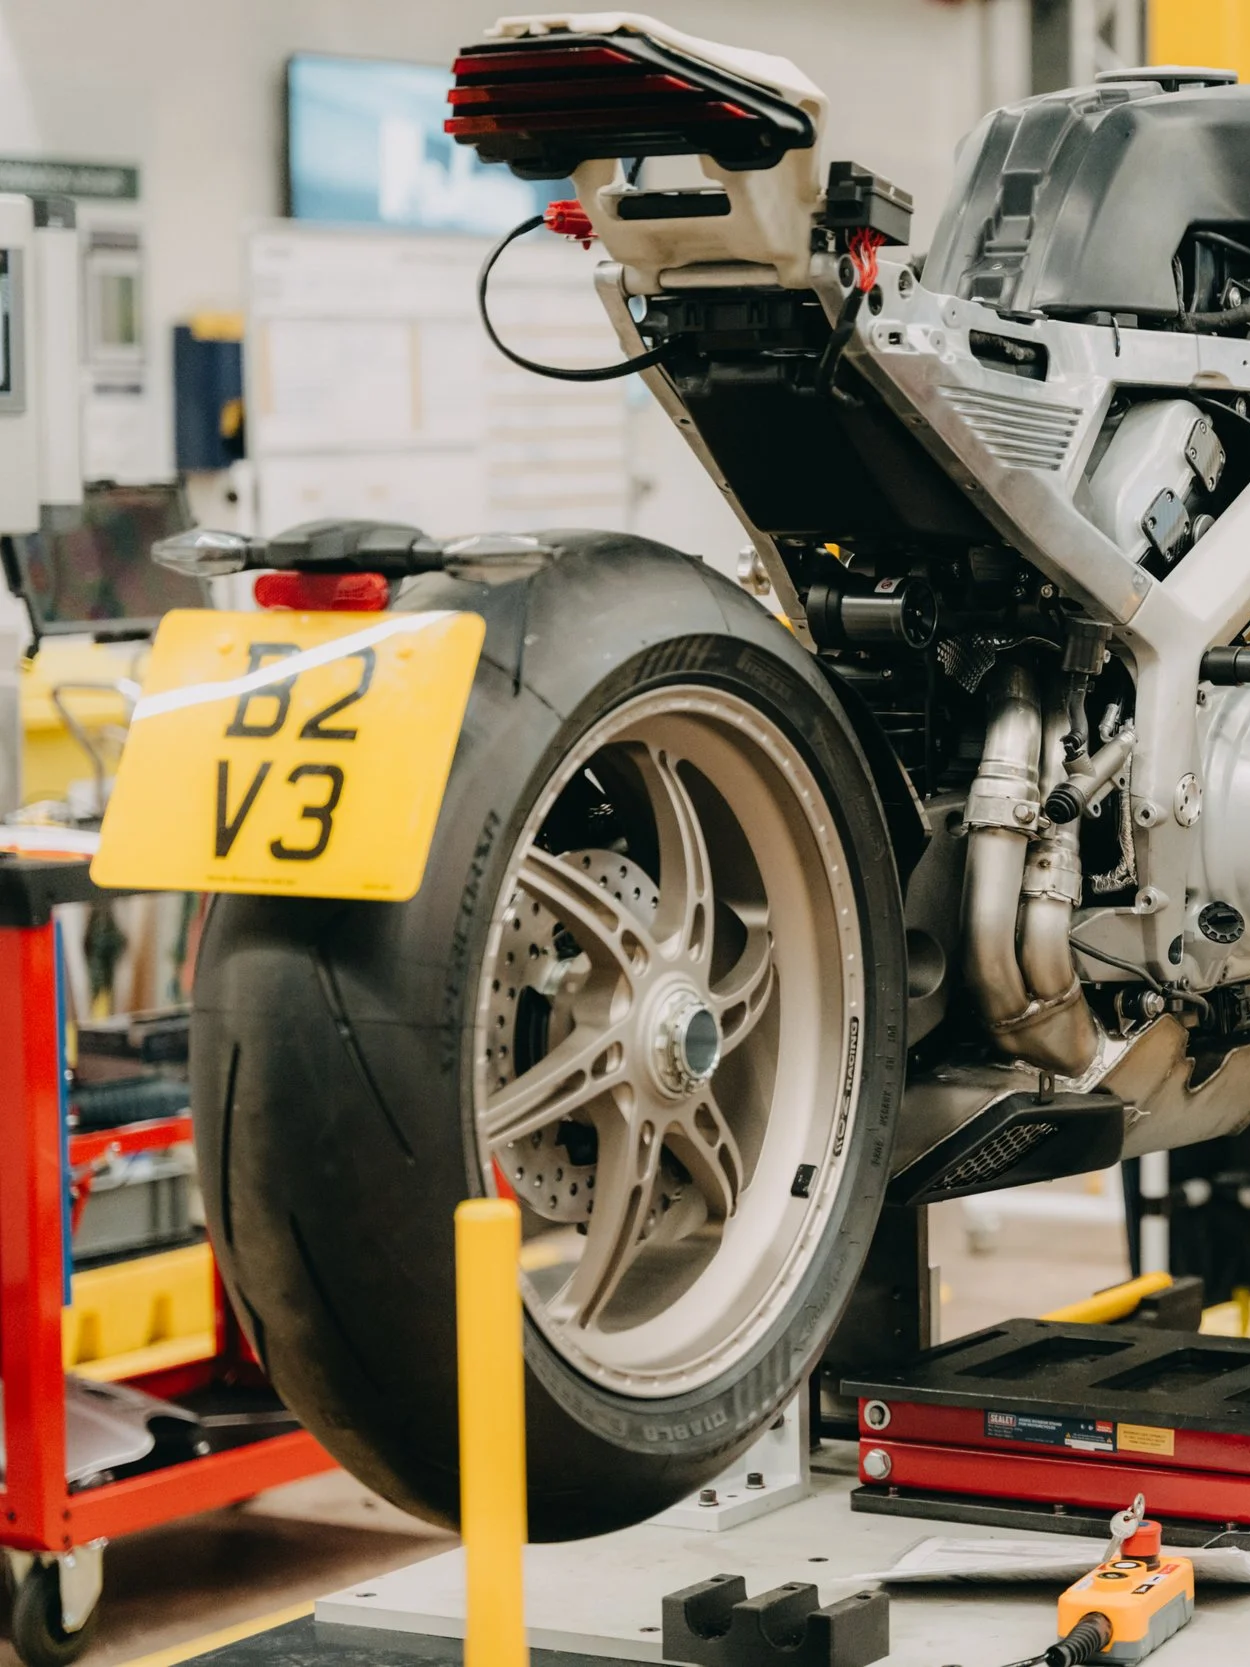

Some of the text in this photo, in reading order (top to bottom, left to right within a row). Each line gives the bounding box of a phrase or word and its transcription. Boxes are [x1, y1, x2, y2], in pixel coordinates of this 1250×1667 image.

[225, 643, 377, 741] B2
[213, 759, 345, 862] V3
[846, 1022, 858, 1091] RACING
[642, 1410, 728, 1442] DIABLO
[990, 1414, 1014, 1425] SEALEY
